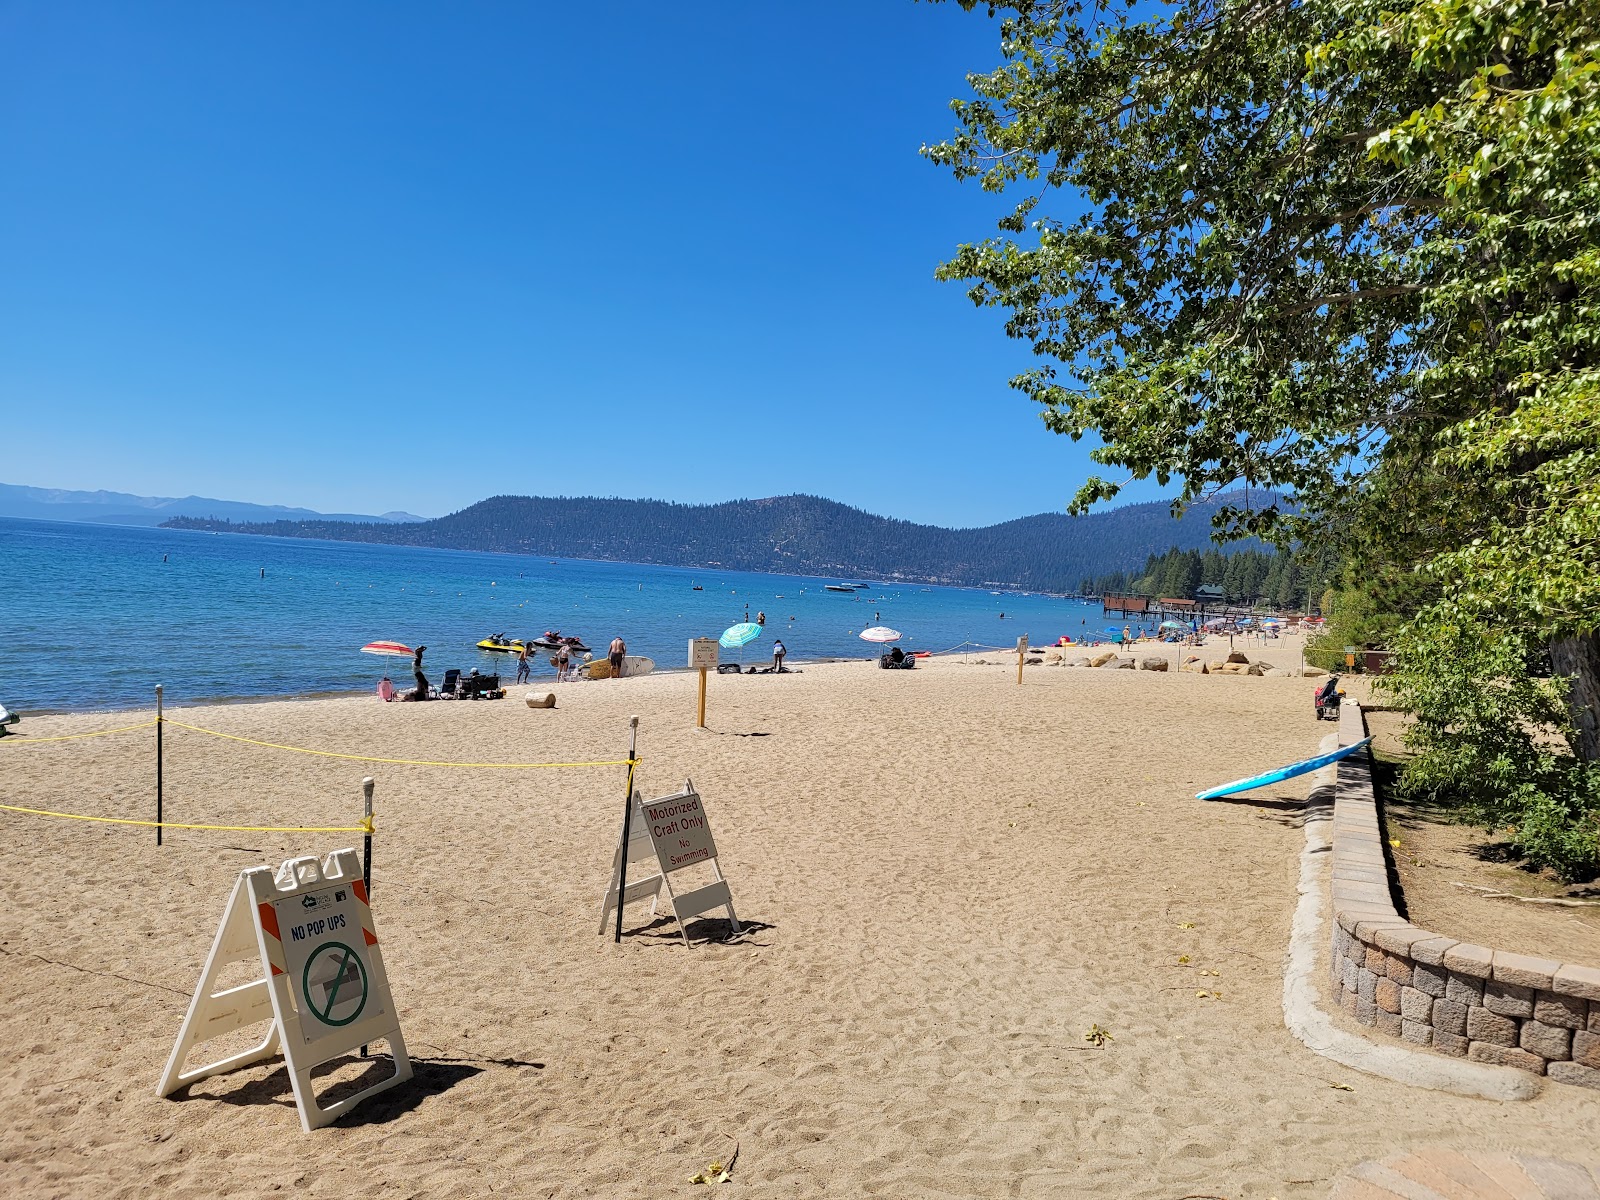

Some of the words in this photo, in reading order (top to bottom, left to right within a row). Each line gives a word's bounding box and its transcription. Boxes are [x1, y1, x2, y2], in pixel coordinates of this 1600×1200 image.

[648, 798, 699, 822] Motorized
[654, 820, 680, 838] Craft
[680, 815, 704, 831] Only
[678, 839, 691, 849] No
[670, 847, 709, 865] Swimming
[291, 925, 306, 942] NO
[306, 919, 325, 937] POP
[326, 913, 346, 931] UPS
